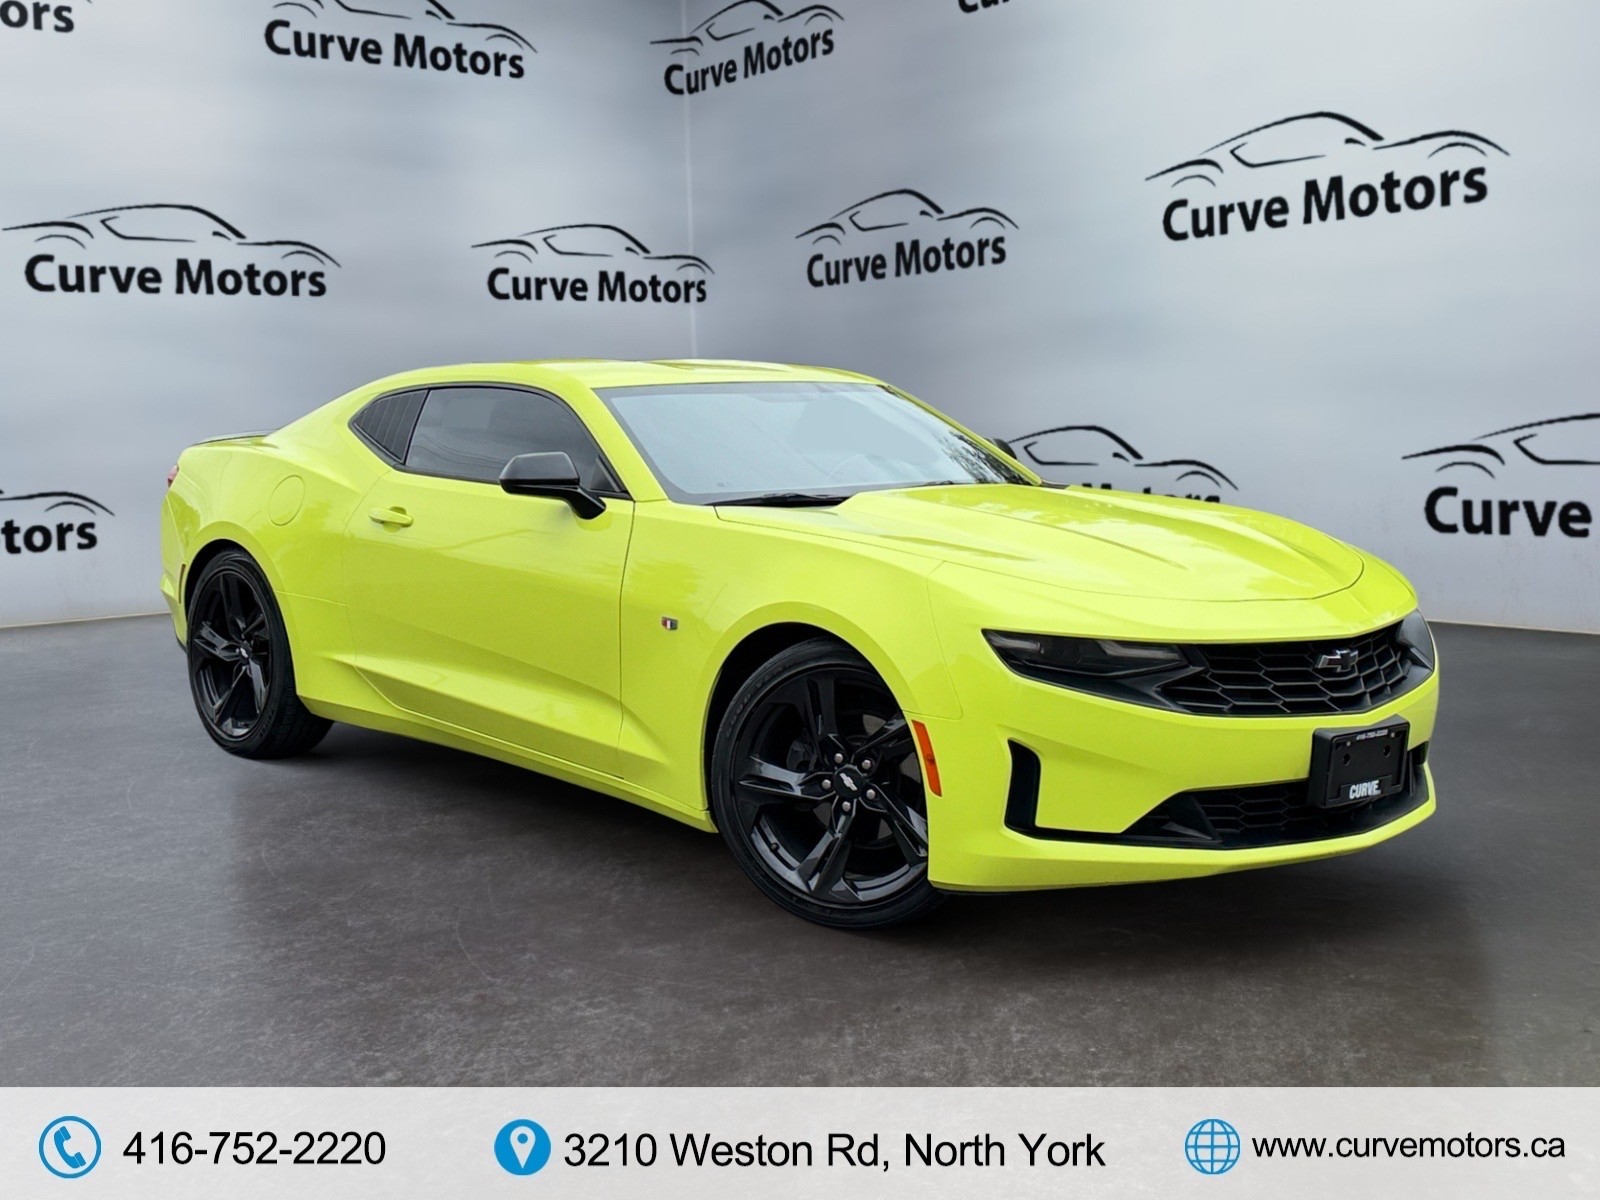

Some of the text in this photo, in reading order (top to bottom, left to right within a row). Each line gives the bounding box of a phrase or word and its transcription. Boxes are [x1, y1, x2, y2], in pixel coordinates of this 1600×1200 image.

[264, 19, 525, 79] Curve Motors
[663, 28, 835, 96] Curve Motors
[1162, 166, 1489, 242] Curve Motors
[24, 254, 327, 297] Curve Motors
[487, 267, 707, 304] Curve Motors
[806, 235, 1007, 288] Curve Motors
[0, 519, 98, 555] tors
[1424, 486, 1593, 538] Curve
